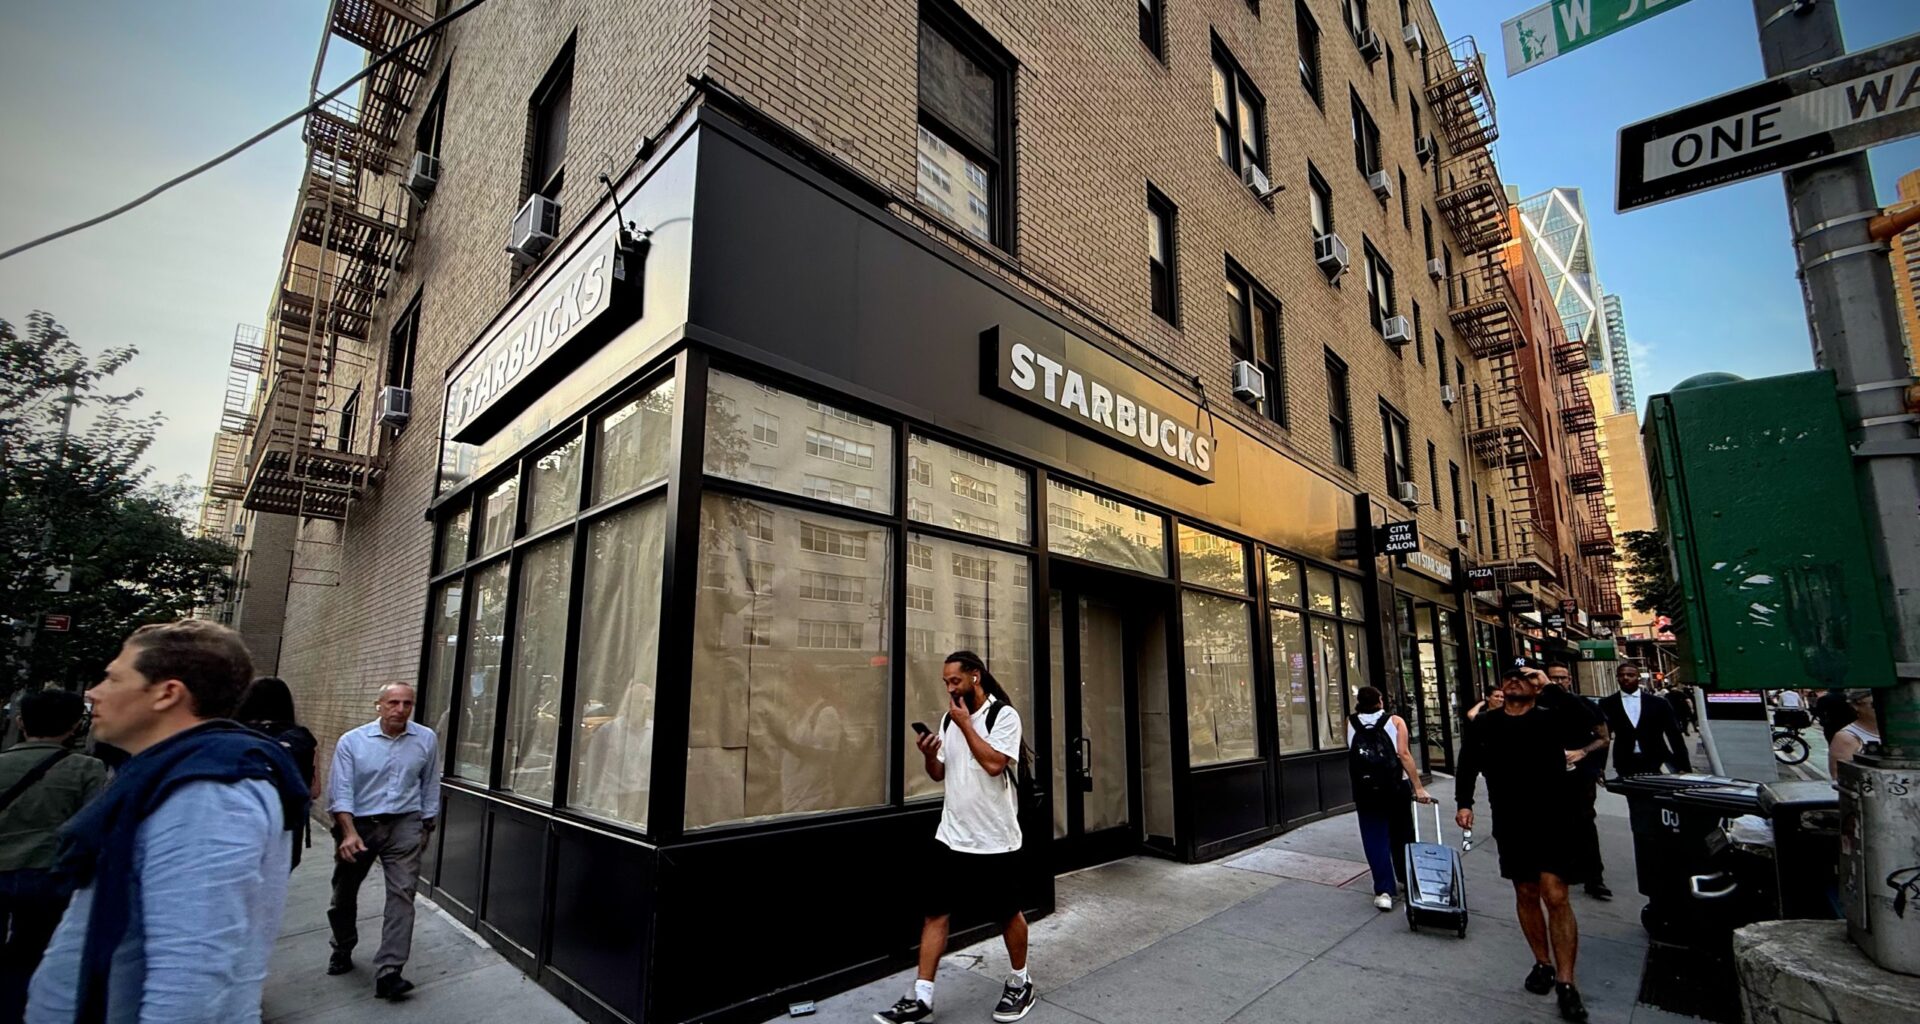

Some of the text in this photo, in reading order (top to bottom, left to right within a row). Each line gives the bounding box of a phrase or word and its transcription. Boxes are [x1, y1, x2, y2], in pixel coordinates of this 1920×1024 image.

[1558, 0, 1590, 42] W
[1671, 106, 1782, 169] ONE
[1664, 188, 1676, 196] OF
[1687, 161, 1777, 189] TRANSPORTATION
[455, 254, 606, 428] STARBUCKS
[1010, 342, 1210, 472] STARBUCKS
[1386, 541, 1416, 551] SALON
[1389, 524, 1410, 533] CITY
[1389, 533, 1412, 542] STAR
[1468, 568, 1493, 578] PIZZA
